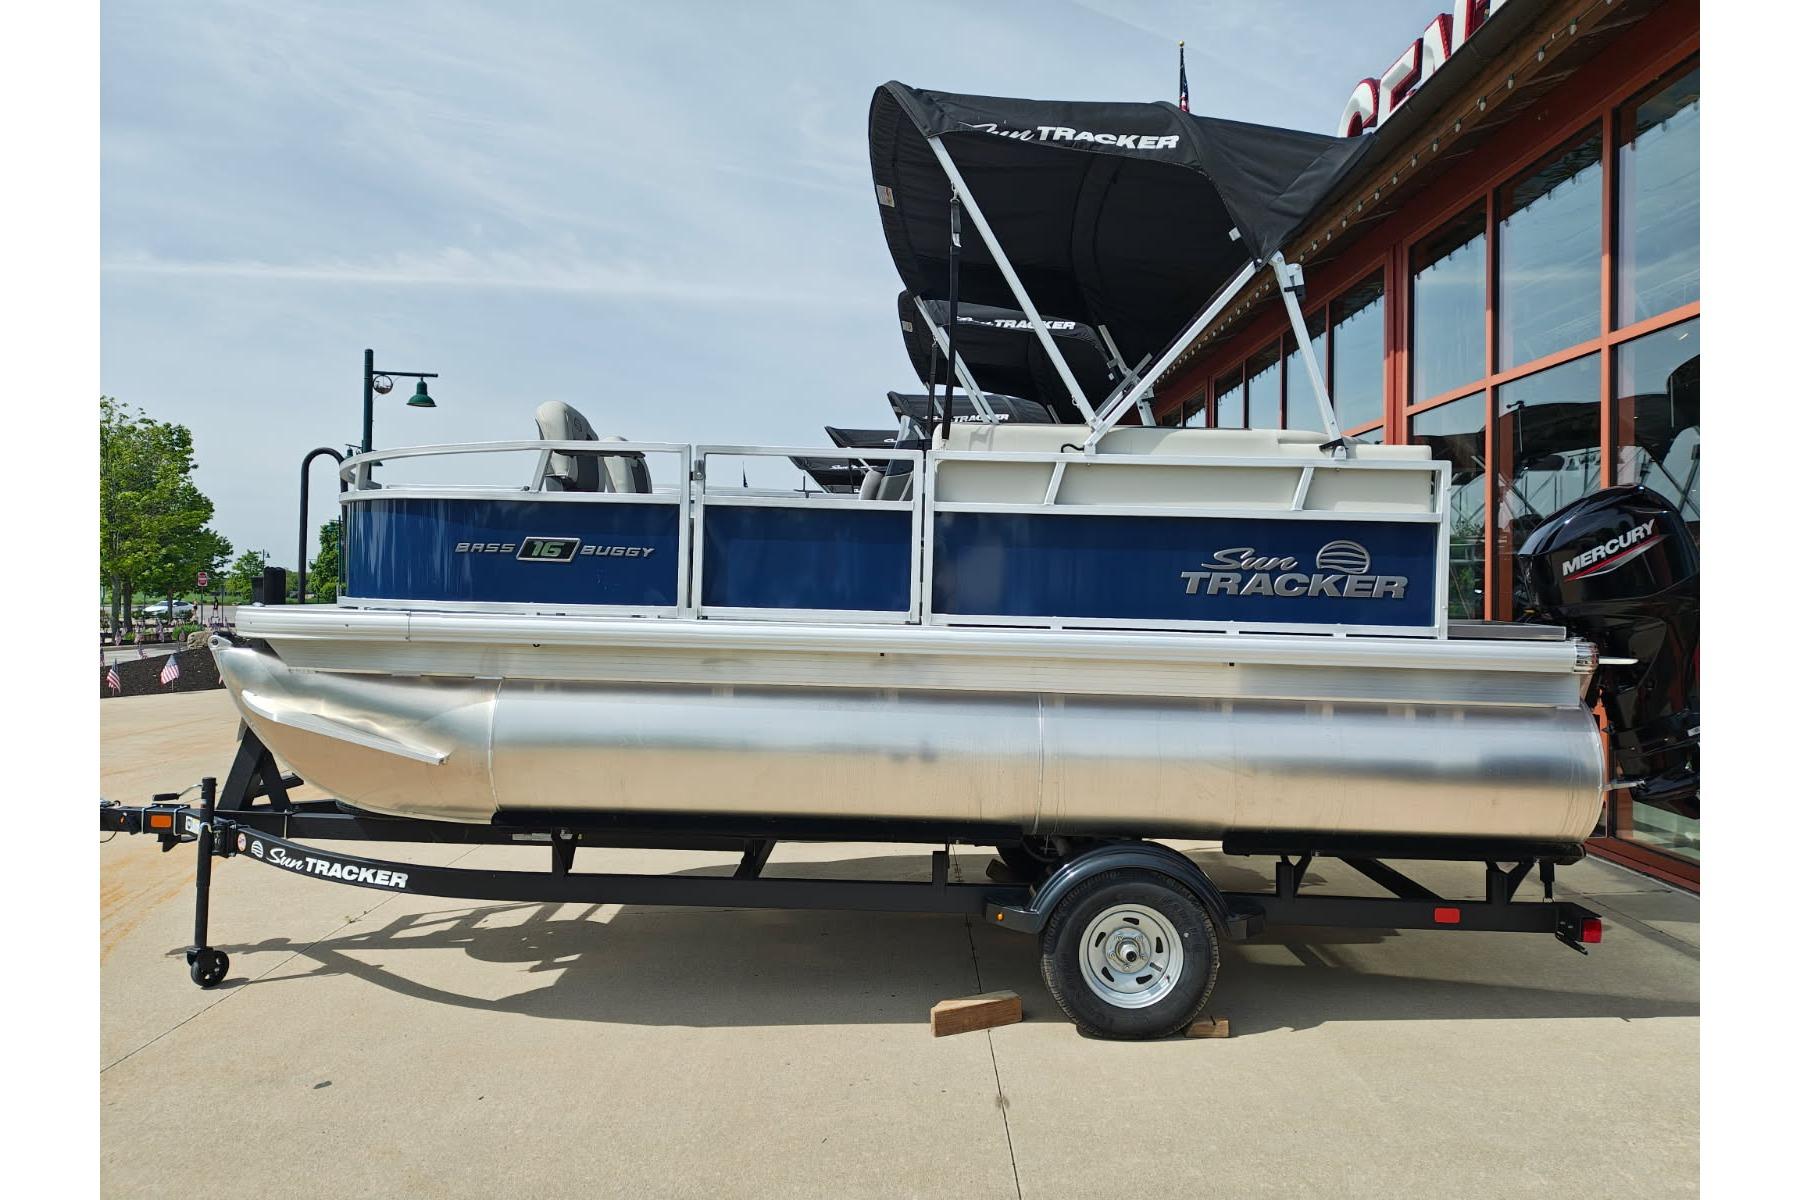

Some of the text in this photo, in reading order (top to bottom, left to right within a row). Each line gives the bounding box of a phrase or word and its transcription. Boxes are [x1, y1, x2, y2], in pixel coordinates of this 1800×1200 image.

[1037, 126, 1180, 149] TRACKER
[455, 540, 655, 558] BASS 16 BUGGY
[1201, 547, 1299, 571] Sun
[1562, 518, 1656, 576] MERCURY
[1180, 571, 1409, 599] TRACKER
[266, 848, 409, 888] Sun TRACKER
